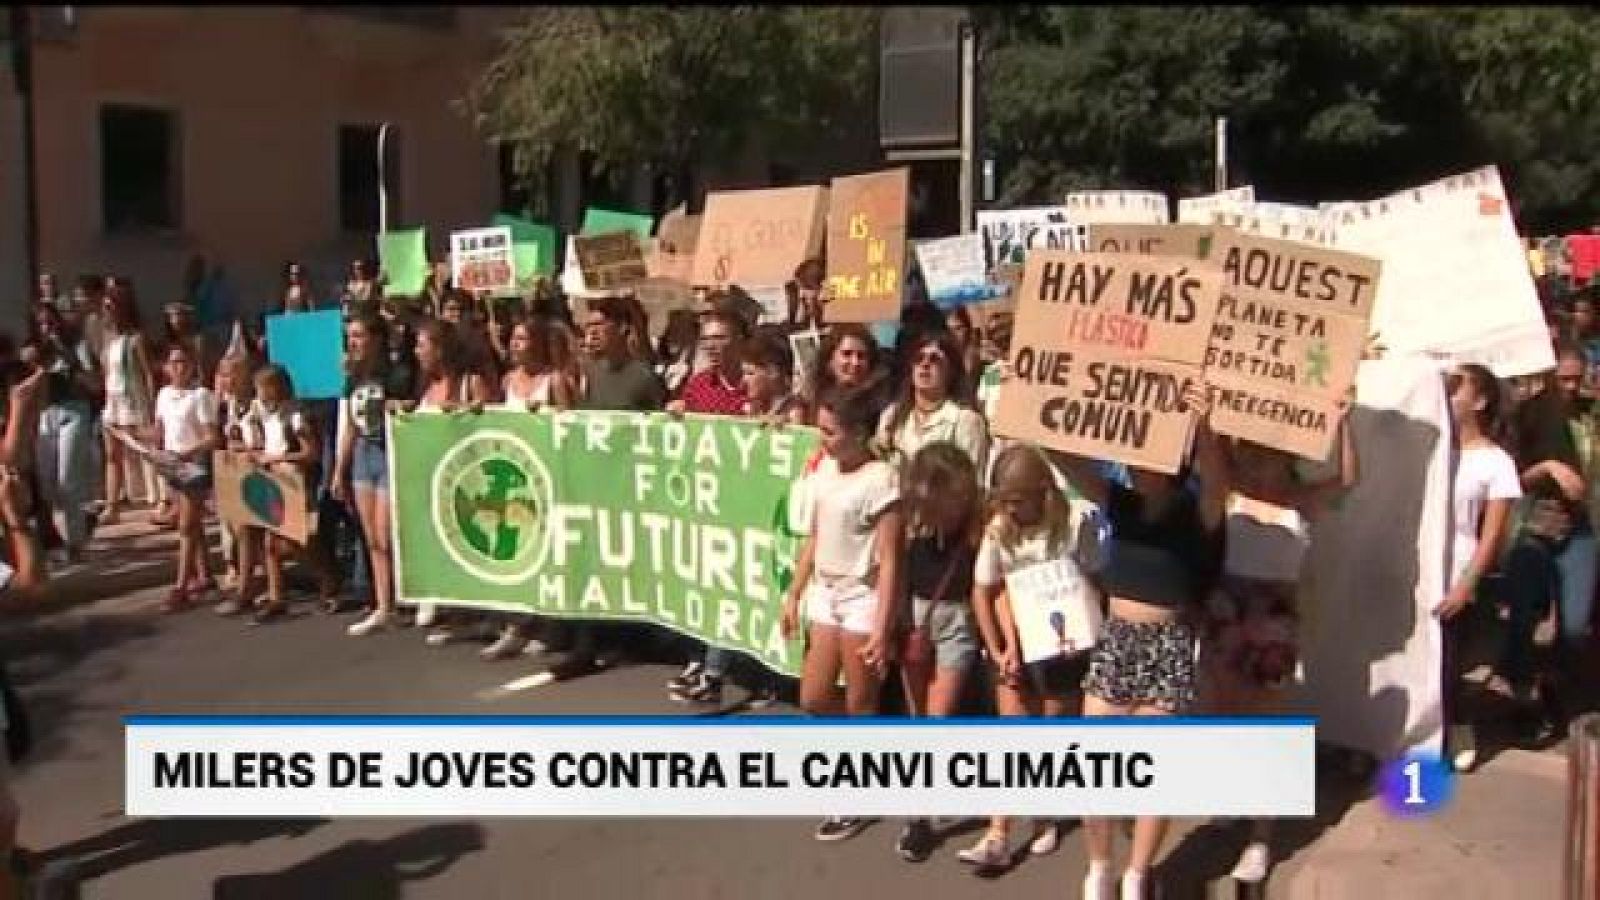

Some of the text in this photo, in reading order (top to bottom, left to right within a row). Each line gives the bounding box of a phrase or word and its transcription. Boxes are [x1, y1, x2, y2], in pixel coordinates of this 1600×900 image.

[1040, 261, 1201, 323] HAY MÁS
[1222, 246, 1372, 306] AQUEST
[1211, 323, 1236, 341] NO
[1216, 295, 1327, 338] PLANETA
[1014, 346, 1074, 386] QUE
[1203, 346, 1297, 385] SORTIDA
[551, 411, 795, 479] FRIDAYS
[1040, 397, 1152, 449] COMUN
[633, 463, 721, 517] FOR
[549, 504, 775, 601] FUTURE
[539, 573, 789, 664] MALLORCA
